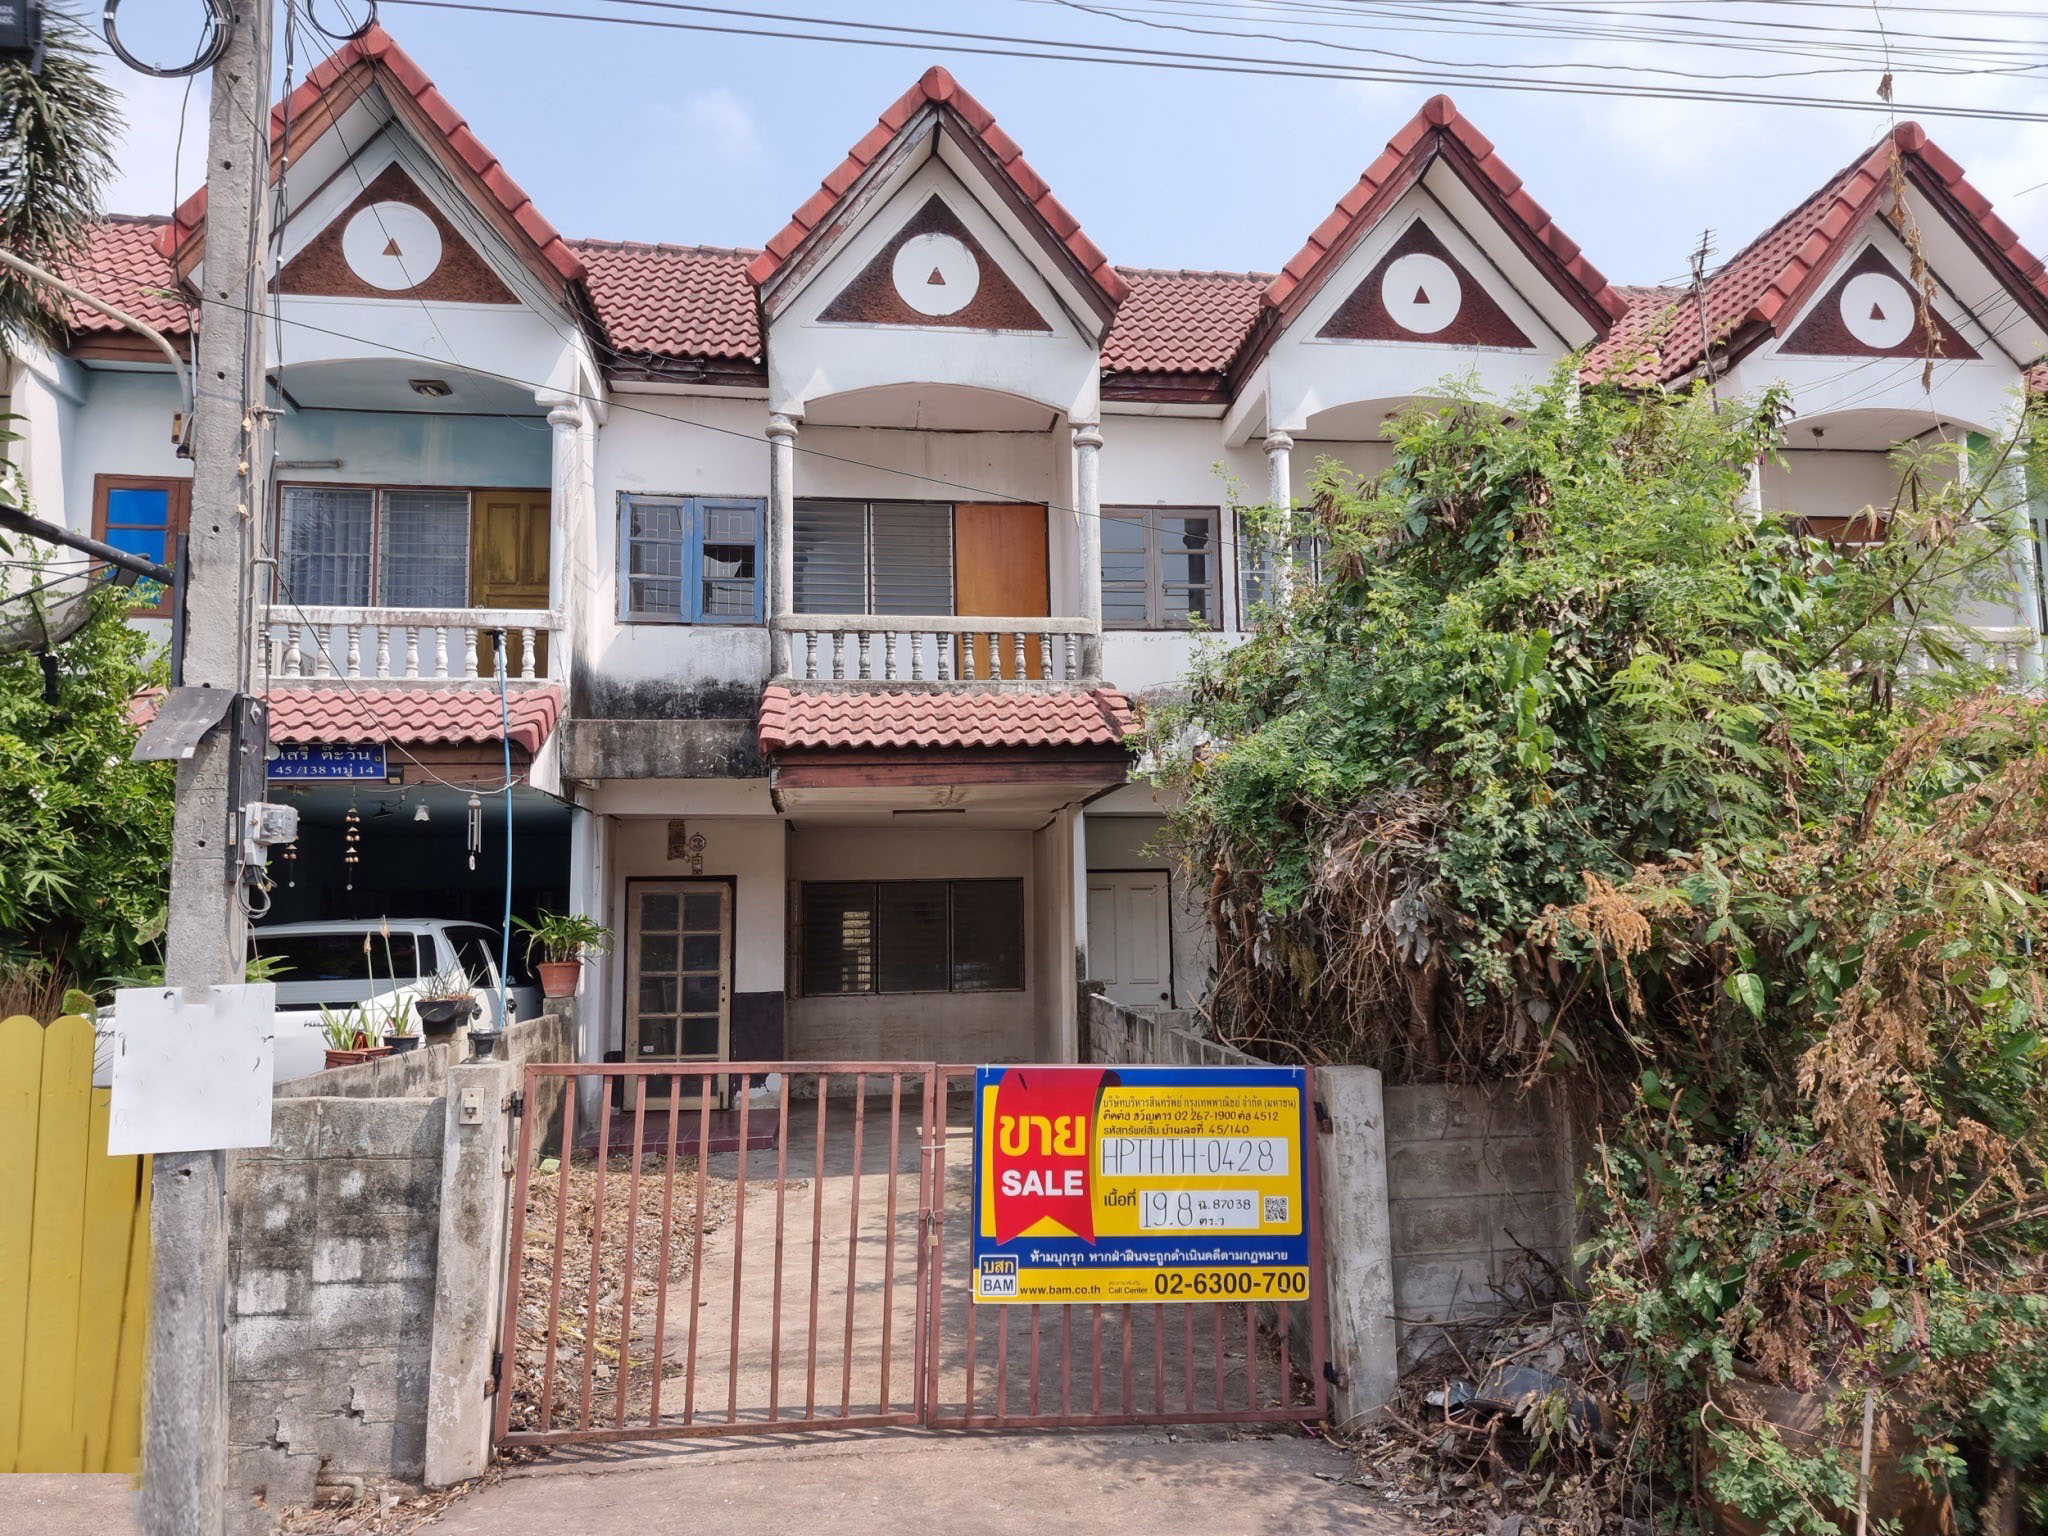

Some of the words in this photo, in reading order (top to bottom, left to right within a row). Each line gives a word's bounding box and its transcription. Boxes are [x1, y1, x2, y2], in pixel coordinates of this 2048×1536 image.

[275, 766, 292, 775] 45
[296, 766, 326, 776] /138
[331, 764, 353, 778] หมู่
[360, 766, 374, 775] 14
[1174, 1111, 1188, 1121] 02
[1190, 1111, 1237, 1121] 267-1900
[1254, 1111, 1279, 1121] 4512
[1000, 1115, 1086, 1157] ขาย
[1103, 1124, 1160, 1135] รหัสทรัพย์สิน
[1208, 1124, 1250, 1135] 45/140
[1102, 1138, 1274, 1174] HPTHTH-0428
[1001, 1169, 1084, 1197] SALE
[1104, 1188, 1137, 1207] เนื้อที่
[1143, 1192, 1193, 1228] 19.8
[1031, 1249, 1085, 1267] ห้ามบุกรุก
[1089, 1248, 1288, 1267] หากฝ่าฝืนจะถูกดำเนินคดีตามกฎหมาย
[983, 1260, 1014, 1274] บสก
[983, 1279, 1014, 1292] BAM
[1019, 1284, 1101, 1295] www.bam.co.th
[1108, 1286, 1122, 1295] Call
[1124, 1286, 1148, 1295] Center
[1154, 1272, 1306, 1295] 02-6300-700
